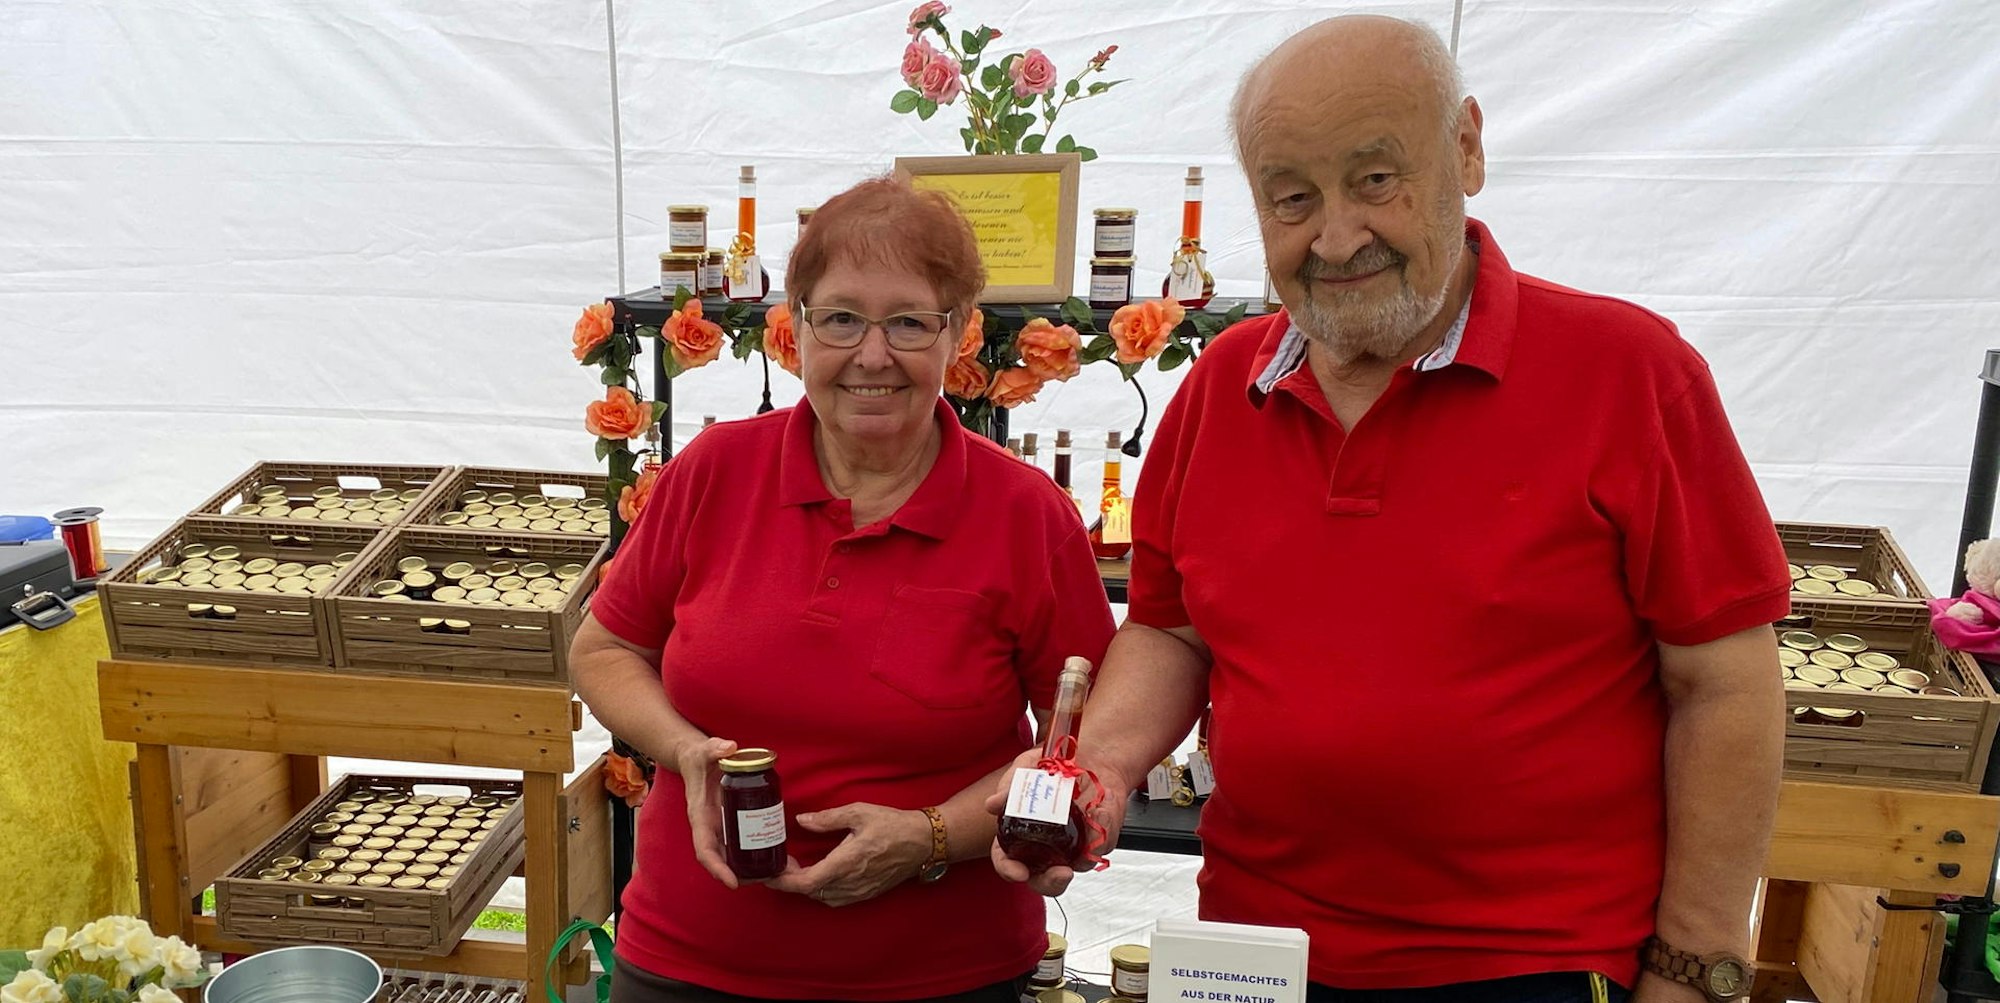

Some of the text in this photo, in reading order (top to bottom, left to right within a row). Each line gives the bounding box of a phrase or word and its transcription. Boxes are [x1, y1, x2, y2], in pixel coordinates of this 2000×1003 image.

[970, 191, 983, 200] ist
[1170, 967, 1288, 987] SELBSTGEMACHTES
[1180, 989, 1205, 1000] AUS
[1208, 991, 1232, 1002] DER
